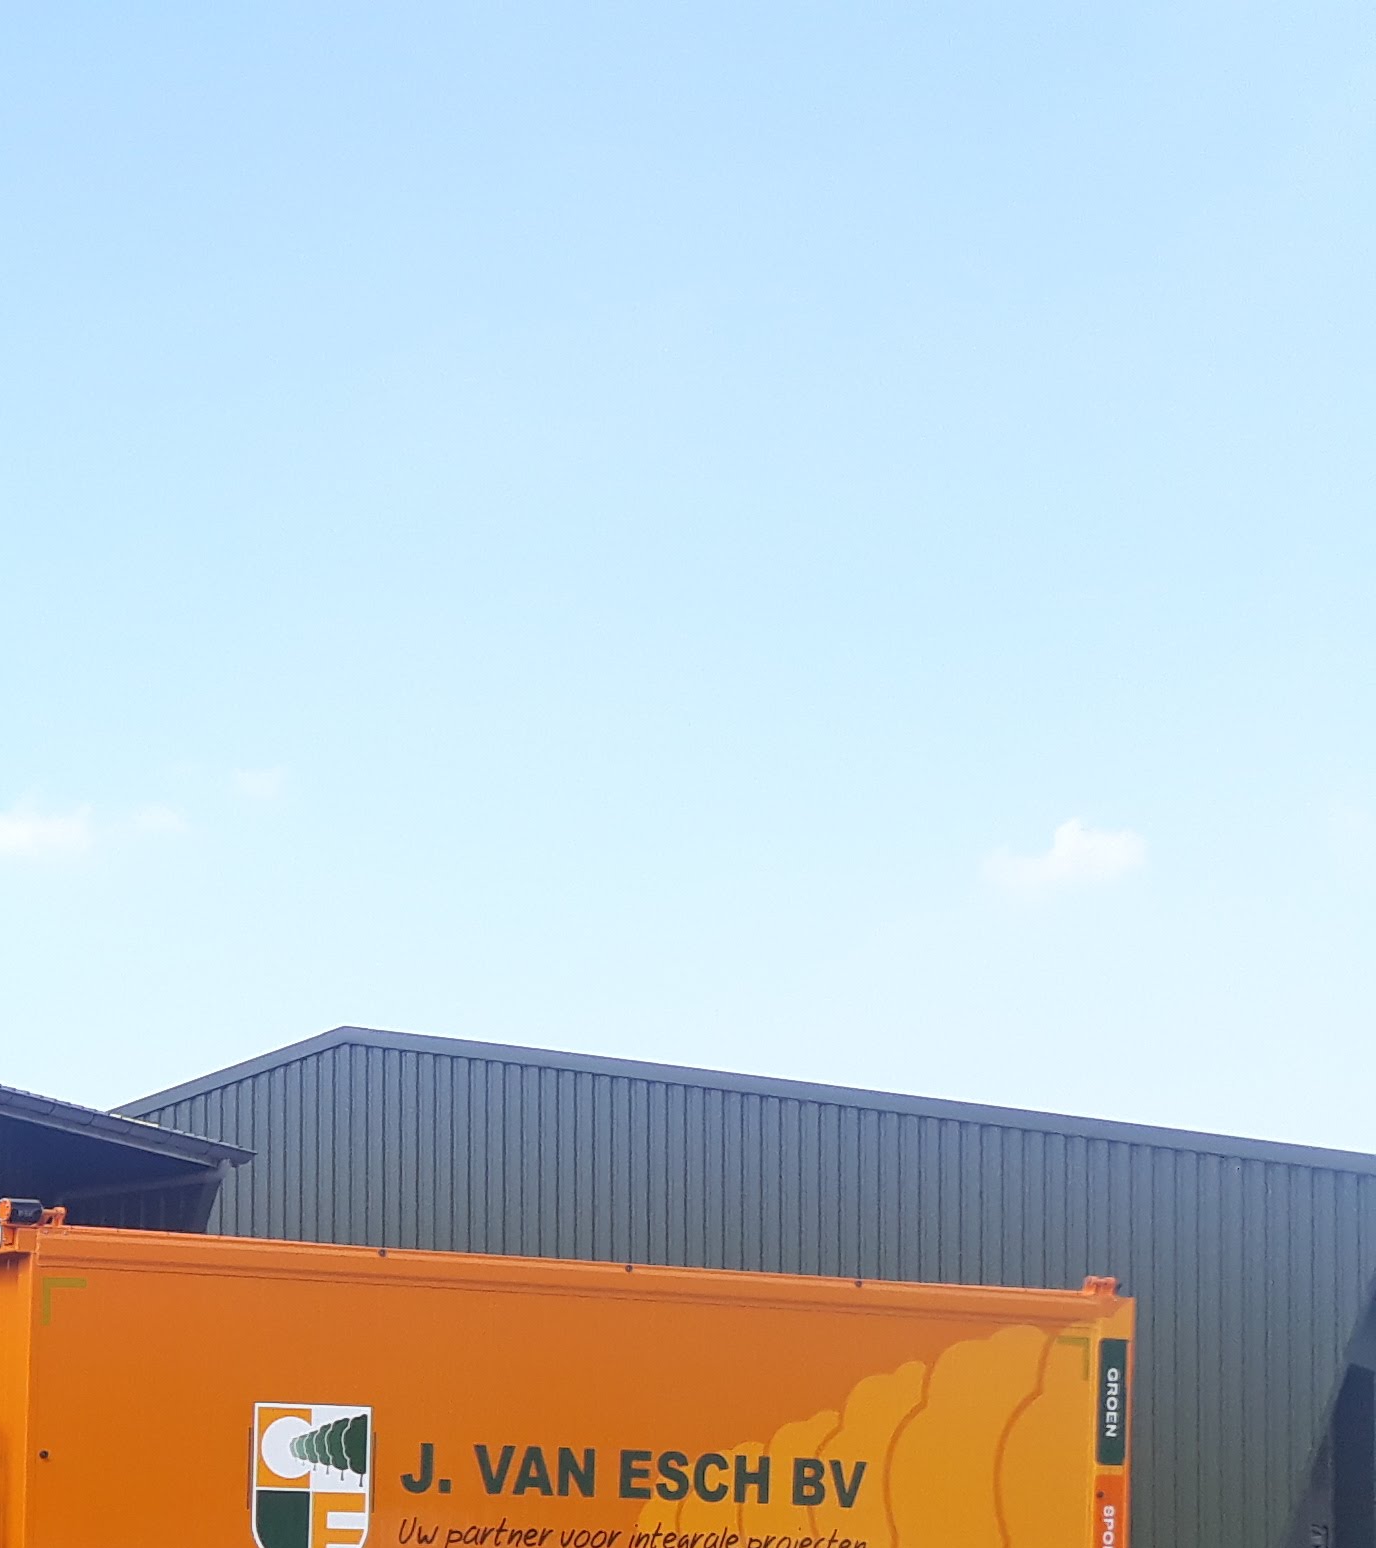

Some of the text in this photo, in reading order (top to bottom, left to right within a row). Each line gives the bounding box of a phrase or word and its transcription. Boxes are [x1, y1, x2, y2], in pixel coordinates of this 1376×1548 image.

[1105, 1367, 1122, 1439] GROEN
[400, 1442, 868, 1509] J. VAN ESCH BV
[399, 1516, 439, 1545] Uw
